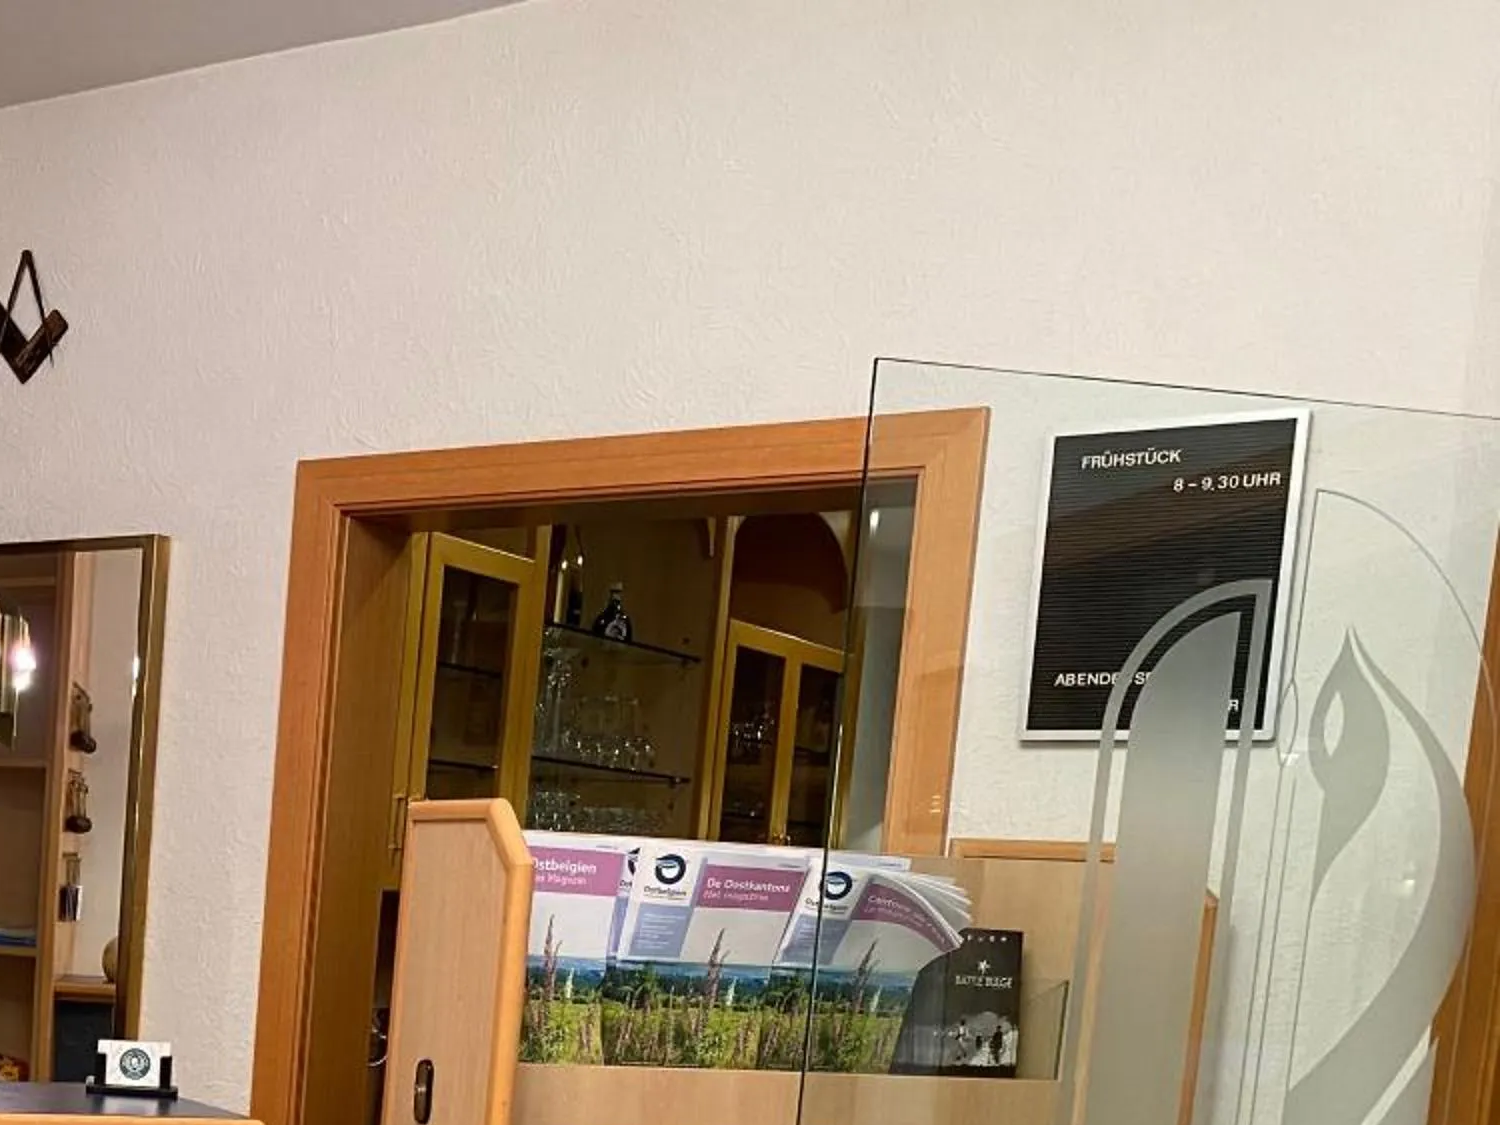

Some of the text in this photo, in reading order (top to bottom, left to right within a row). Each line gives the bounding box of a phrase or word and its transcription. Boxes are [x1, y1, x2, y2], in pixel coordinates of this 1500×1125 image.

[1081, 447, 1182, 470] FRÜHSTÜCK
[1173, 478, 1184, 493] 8
[1243, 472, 1282, 488] UHR
[1054, 671, 1152, 687] ABENDES
